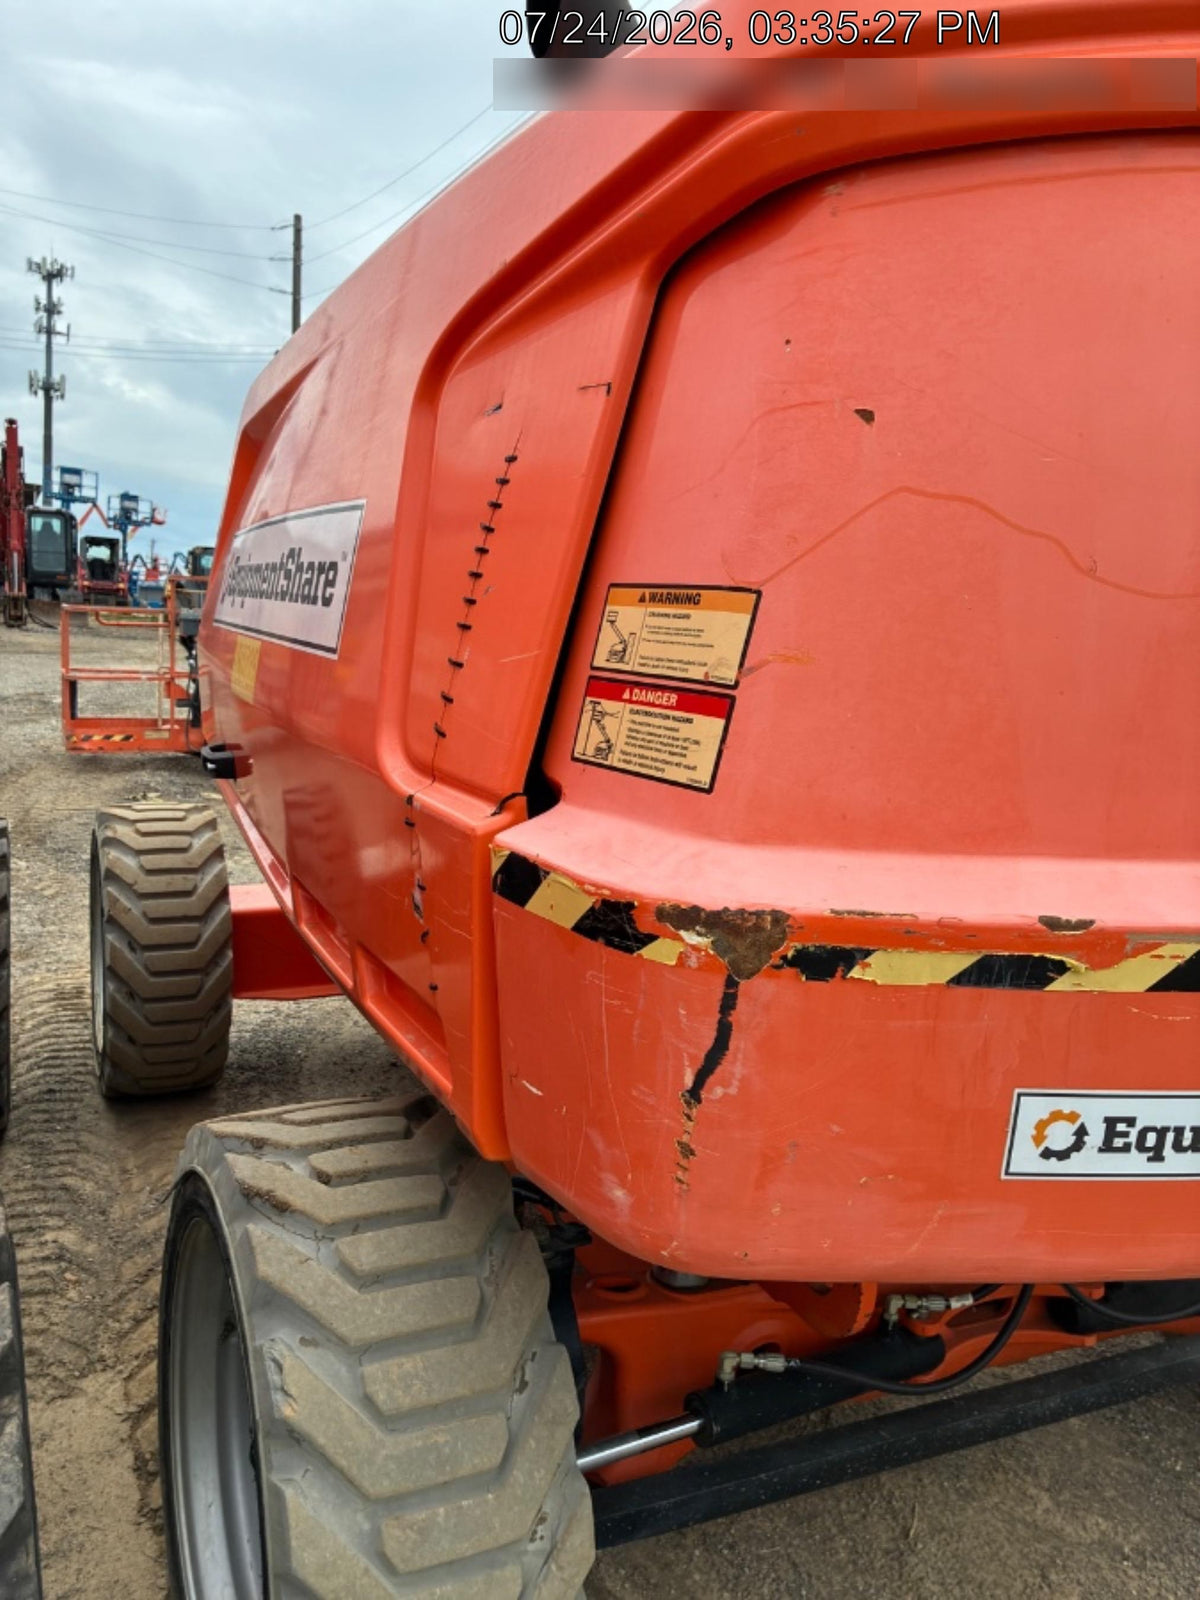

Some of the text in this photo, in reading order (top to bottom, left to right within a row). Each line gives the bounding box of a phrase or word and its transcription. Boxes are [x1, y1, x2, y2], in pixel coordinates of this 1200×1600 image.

[648, 591, 701, 606] WARNING
[631, 688, 679, 707] DANGER
[1097, 1116, 1200, 1163] Equ
